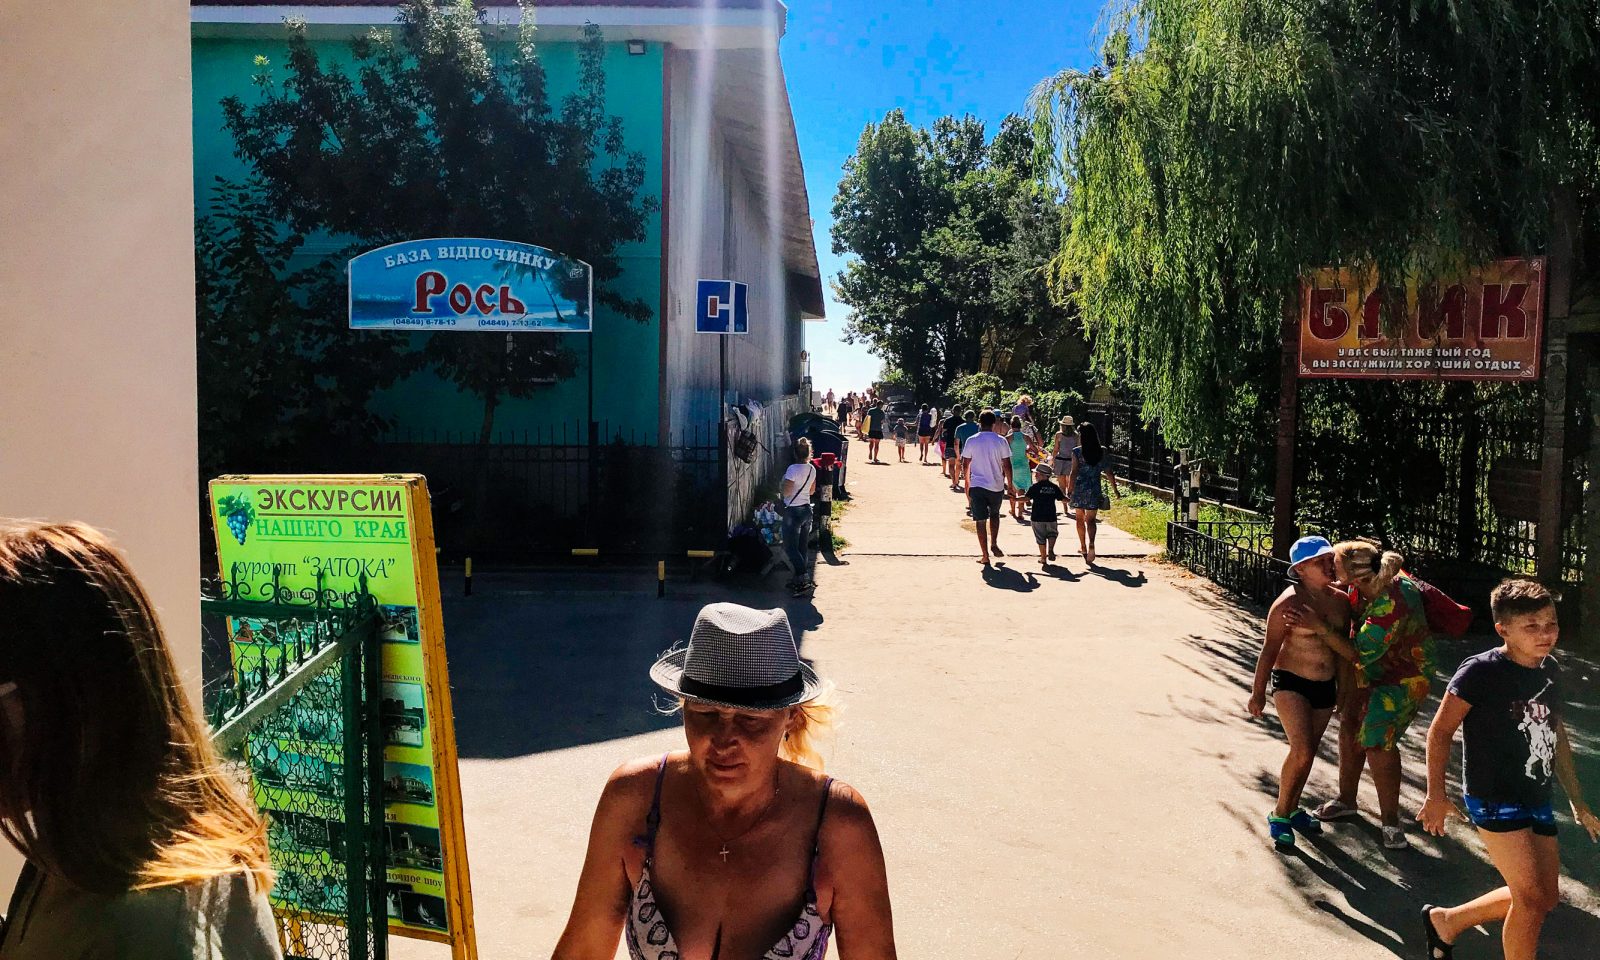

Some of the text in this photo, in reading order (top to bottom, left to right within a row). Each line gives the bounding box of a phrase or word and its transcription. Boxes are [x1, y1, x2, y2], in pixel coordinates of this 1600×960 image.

[384, 246, 557, 270] БАЗА ВІДПОЧИНКУ
[411, 271, 526, 315] Рось
[478, 319, 509, 328] (04849)
[1348, 348, 1369, 357] ВАС
[1465, 348, 1491, 358] ГОД
[1312, 360, 1329, 369] ВЫ
[1474, 360, 1521, 370] ОТДЫХ
[257, 488, 403, 512] ЭКСКУРСИИ
[255, 518, 407, 539] НАШЕГО КРАЯ
